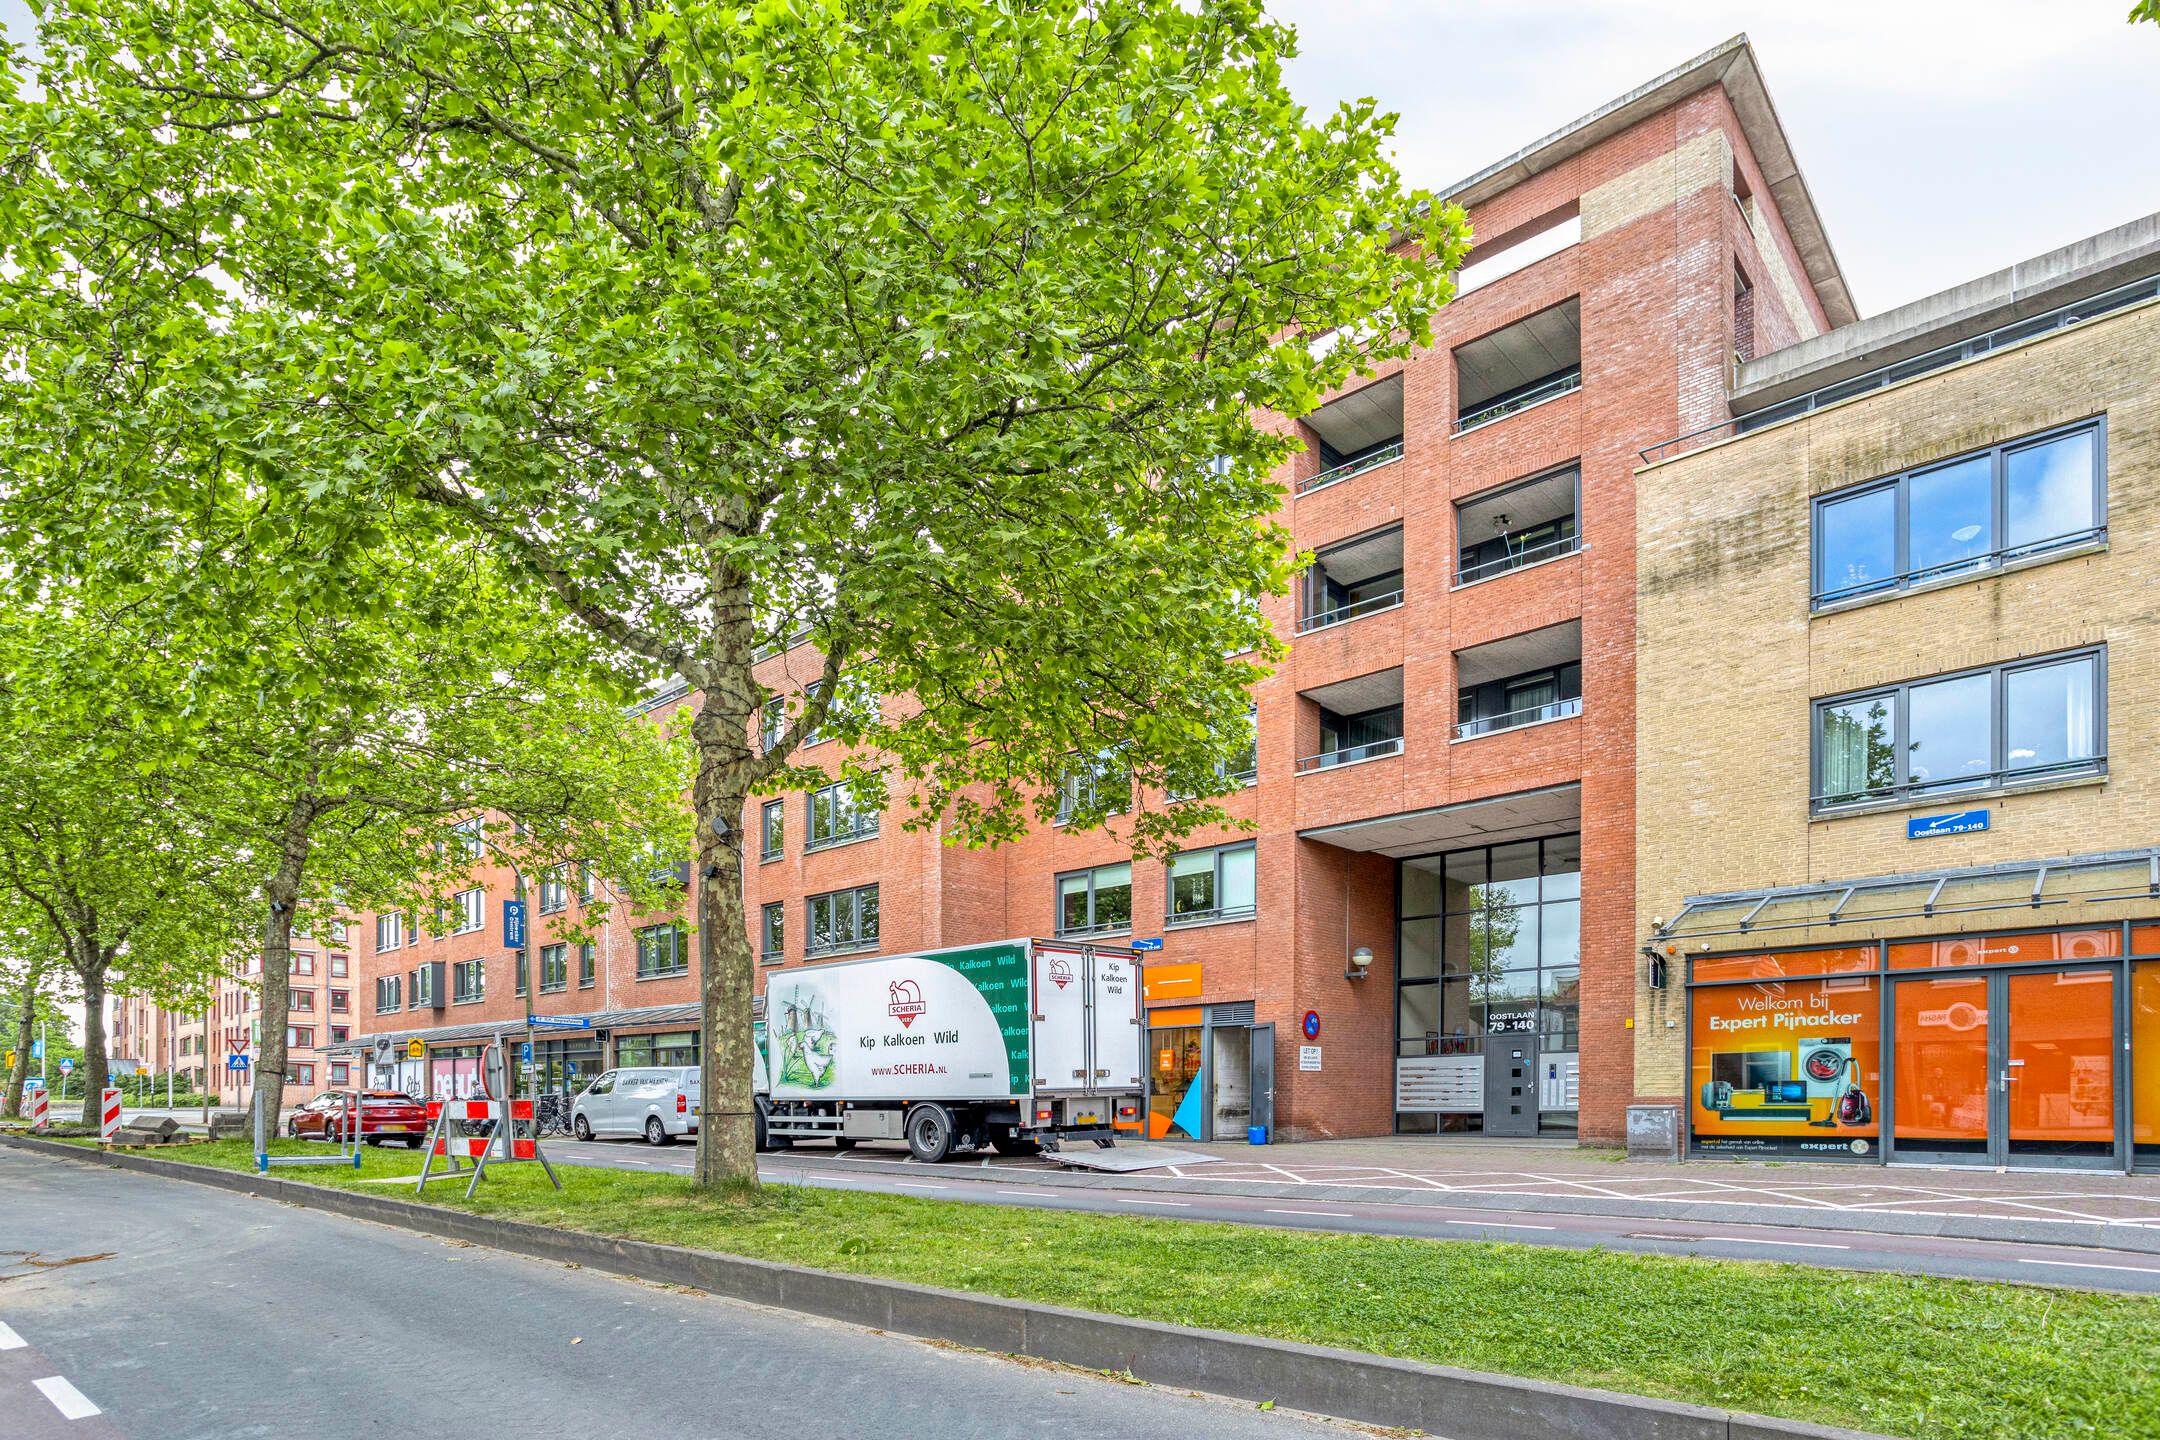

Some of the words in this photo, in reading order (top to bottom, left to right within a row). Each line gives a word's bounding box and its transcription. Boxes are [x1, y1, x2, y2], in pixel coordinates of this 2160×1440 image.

[1914, 827, 1950, 836] Oostlaan
[1953, 822, 1984, 832] 79-140
[960, 959, 991, 970] Kalkoen
[997, 954, 1016, 966] Wild
[1109, 962, 1120, 972] Kip
[1101, 974, 1128, 983] Kalkoen
[1107, 986, 1122, 994] Wild
[1738, 995, 1803, 1011] Welkom
[1810, 993, 1829, 1012] bij
[892, 1004, 922, 1014] SCHERIA
[1489, 1012, 1534, 1020] OOSTLAAN
[1710, 1015, 1767, 1032] Expert
[1773, 1010, 1862, 1030] Pijnacker
[860, 1035, 875, 1051] Kip
[883, 1033, 925, 1046] Kalkoen
[934, 1030, 959, 1044] Wild
[1800, 1142, 1848, 1150] expert
